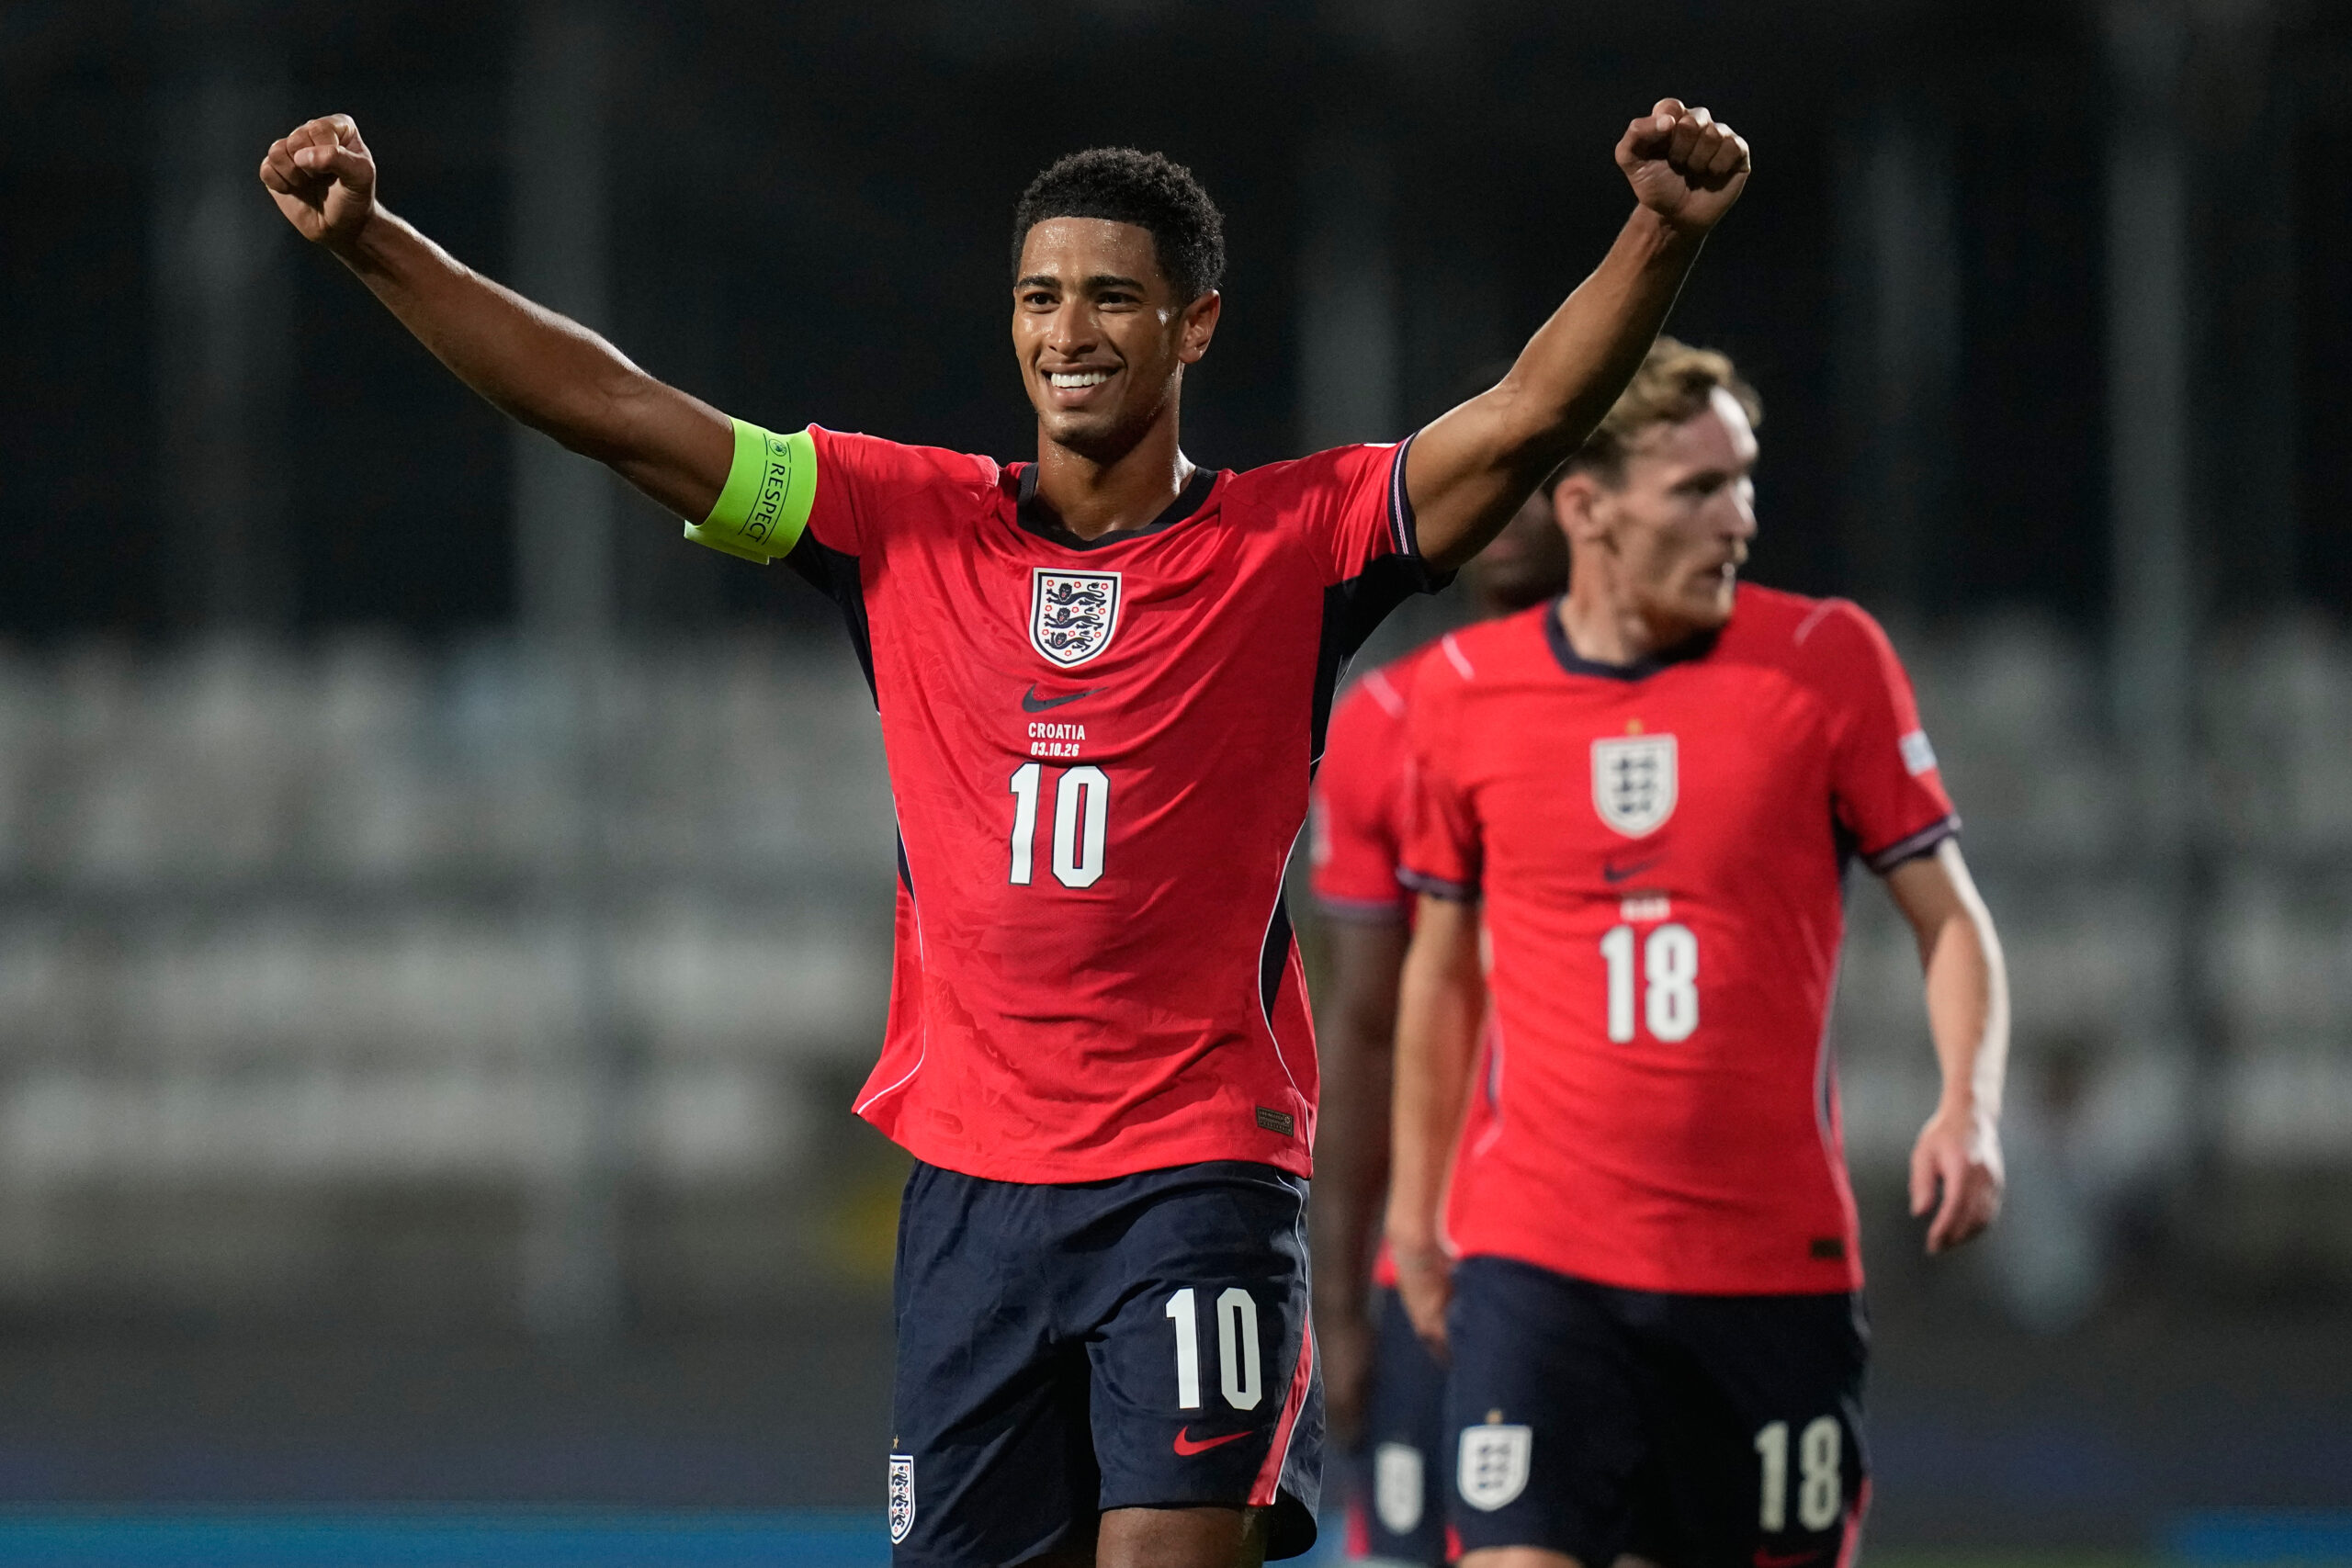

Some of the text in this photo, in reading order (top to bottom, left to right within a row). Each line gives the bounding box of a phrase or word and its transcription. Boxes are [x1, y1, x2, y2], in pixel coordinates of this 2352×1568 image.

[746, 462, 786, 544] RESPECT
[1028, 722, 1085, 739] CROATIA
[1030, 741, 1080, 757] 03.10.26
[1009, 761, 1111, 889] 10
[1600, 923, 1699, 1043] 18
[1165, 1287, 1262, 1411] 10
[1754, 1415, 1842, 1532] 18
